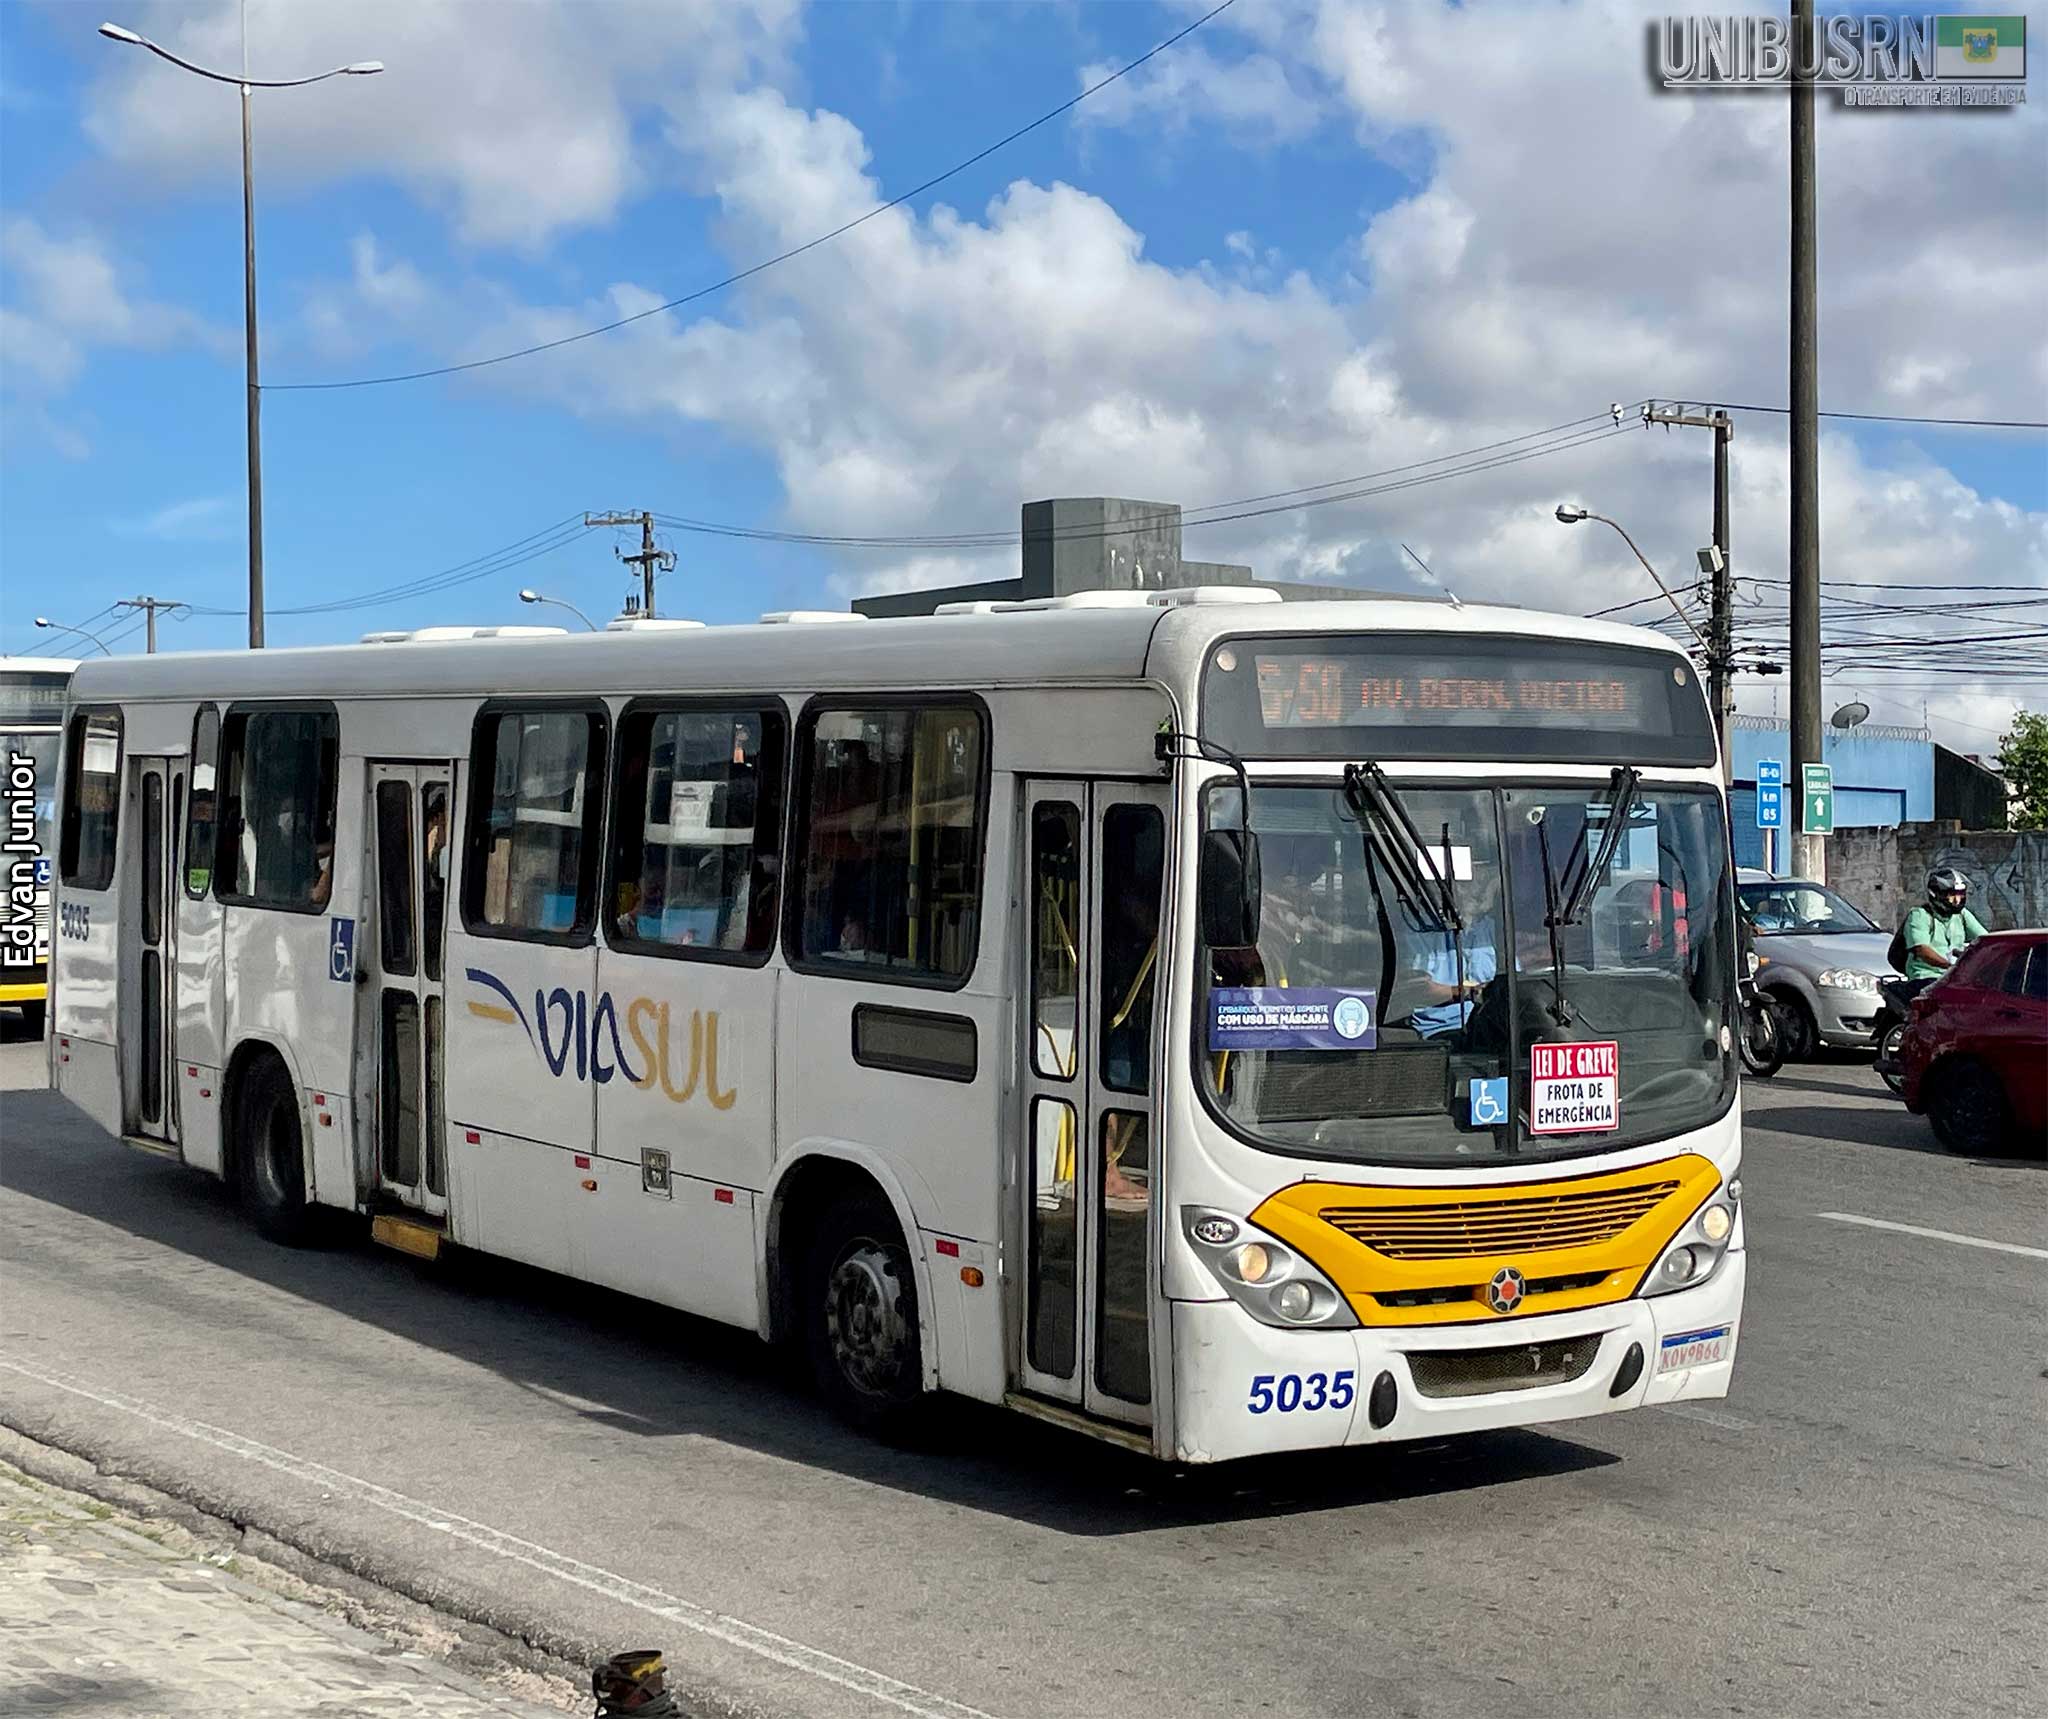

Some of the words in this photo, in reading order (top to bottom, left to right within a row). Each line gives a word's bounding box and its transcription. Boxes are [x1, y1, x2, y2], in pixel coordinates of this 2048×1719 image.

[60, 902, 90, 942] 5035
[1217, 1014, 1241, 1025] COM
[1242, 1014, 1264, 1025] USO
[1265, 1014, 1280, 1025] DE
[1280, 1012, 1329, 1025] MÁSCARA
[1535, 1049, 1553, 1077] LEI
[1557, 1048, 1573, 1076] DE
[1576, 1046, 1616, 1075] GREVE
[1547, 1083, 1584, 1101] FROTA
[1588, 1082, 1604, 1099] DE
[1538, 1101, 1613, 1125] EMERGÊNCIA
[1246, 1370, 1355, 1414] 5035
